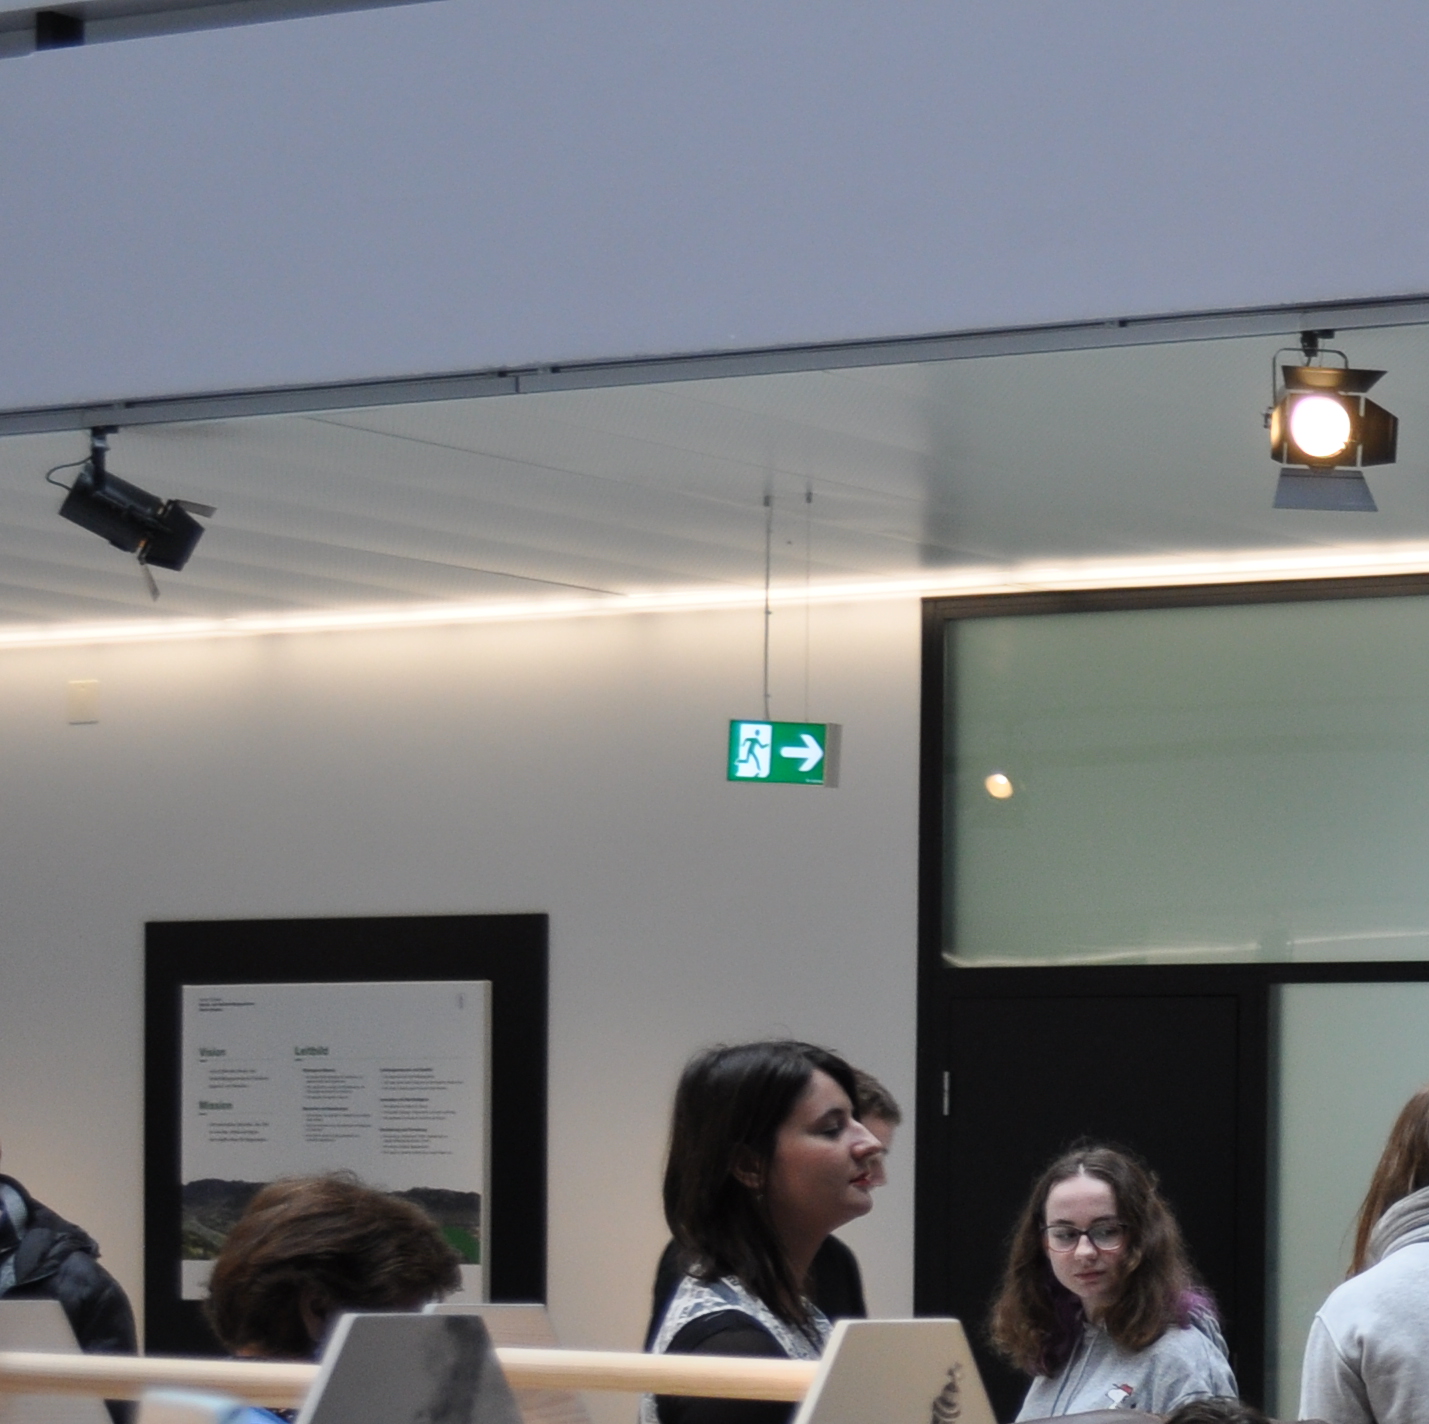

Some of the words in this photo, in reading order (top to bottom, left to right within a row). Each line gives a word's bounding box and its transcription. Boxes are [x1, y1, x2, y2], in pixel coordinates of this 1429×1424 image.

[198, 1046, 227, 1058] Vision
[294, 1045, 330, 1057] Leitbild
[198, 1101, 233, 1111] Mission
